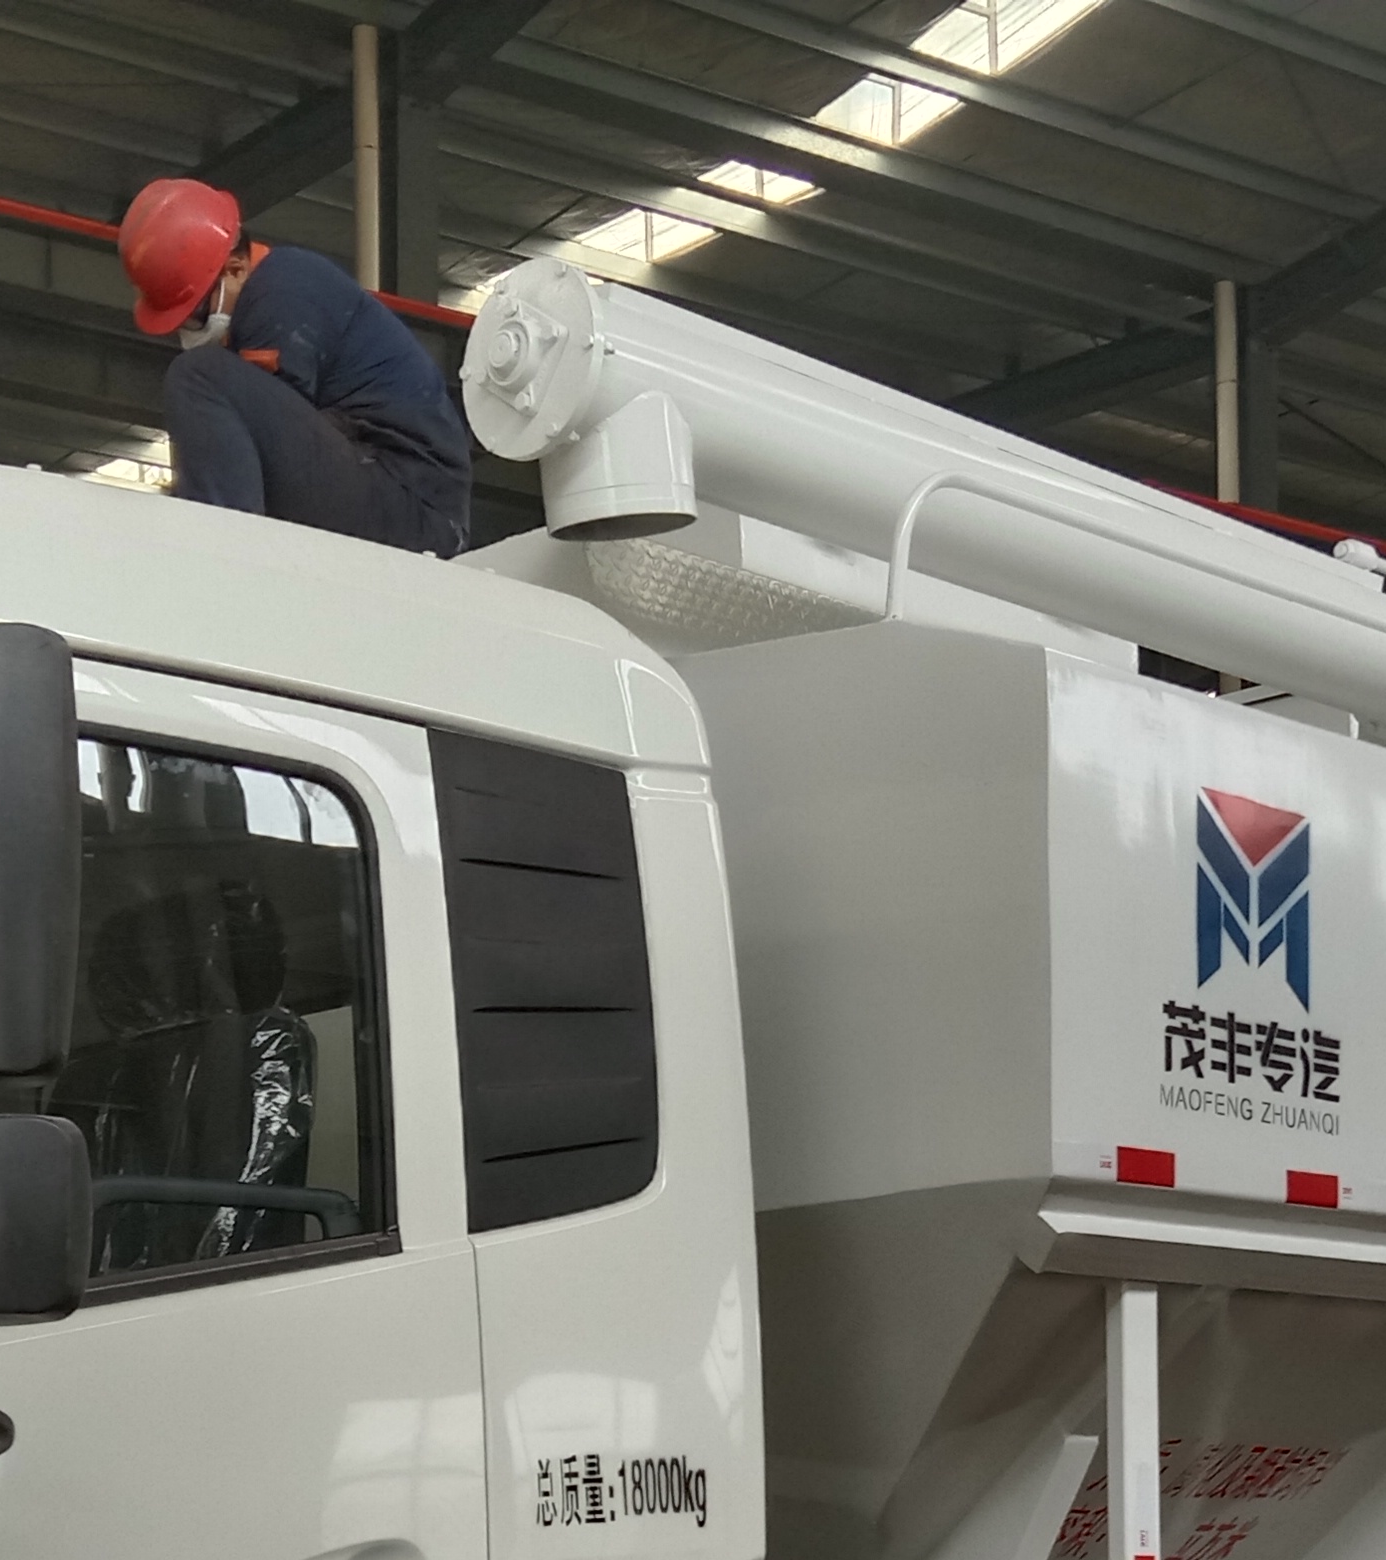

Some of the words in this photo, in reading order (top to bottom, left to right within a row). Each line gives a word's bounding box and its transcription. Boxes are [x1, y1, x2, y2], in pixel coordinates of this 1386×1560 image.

[1162, 1000, 1342, 1102] 茂丰专汽
[1160, 1084, 1253, 1121] MAOFENG
[1261, 1101, 1341, 1137] ZHUANQI
